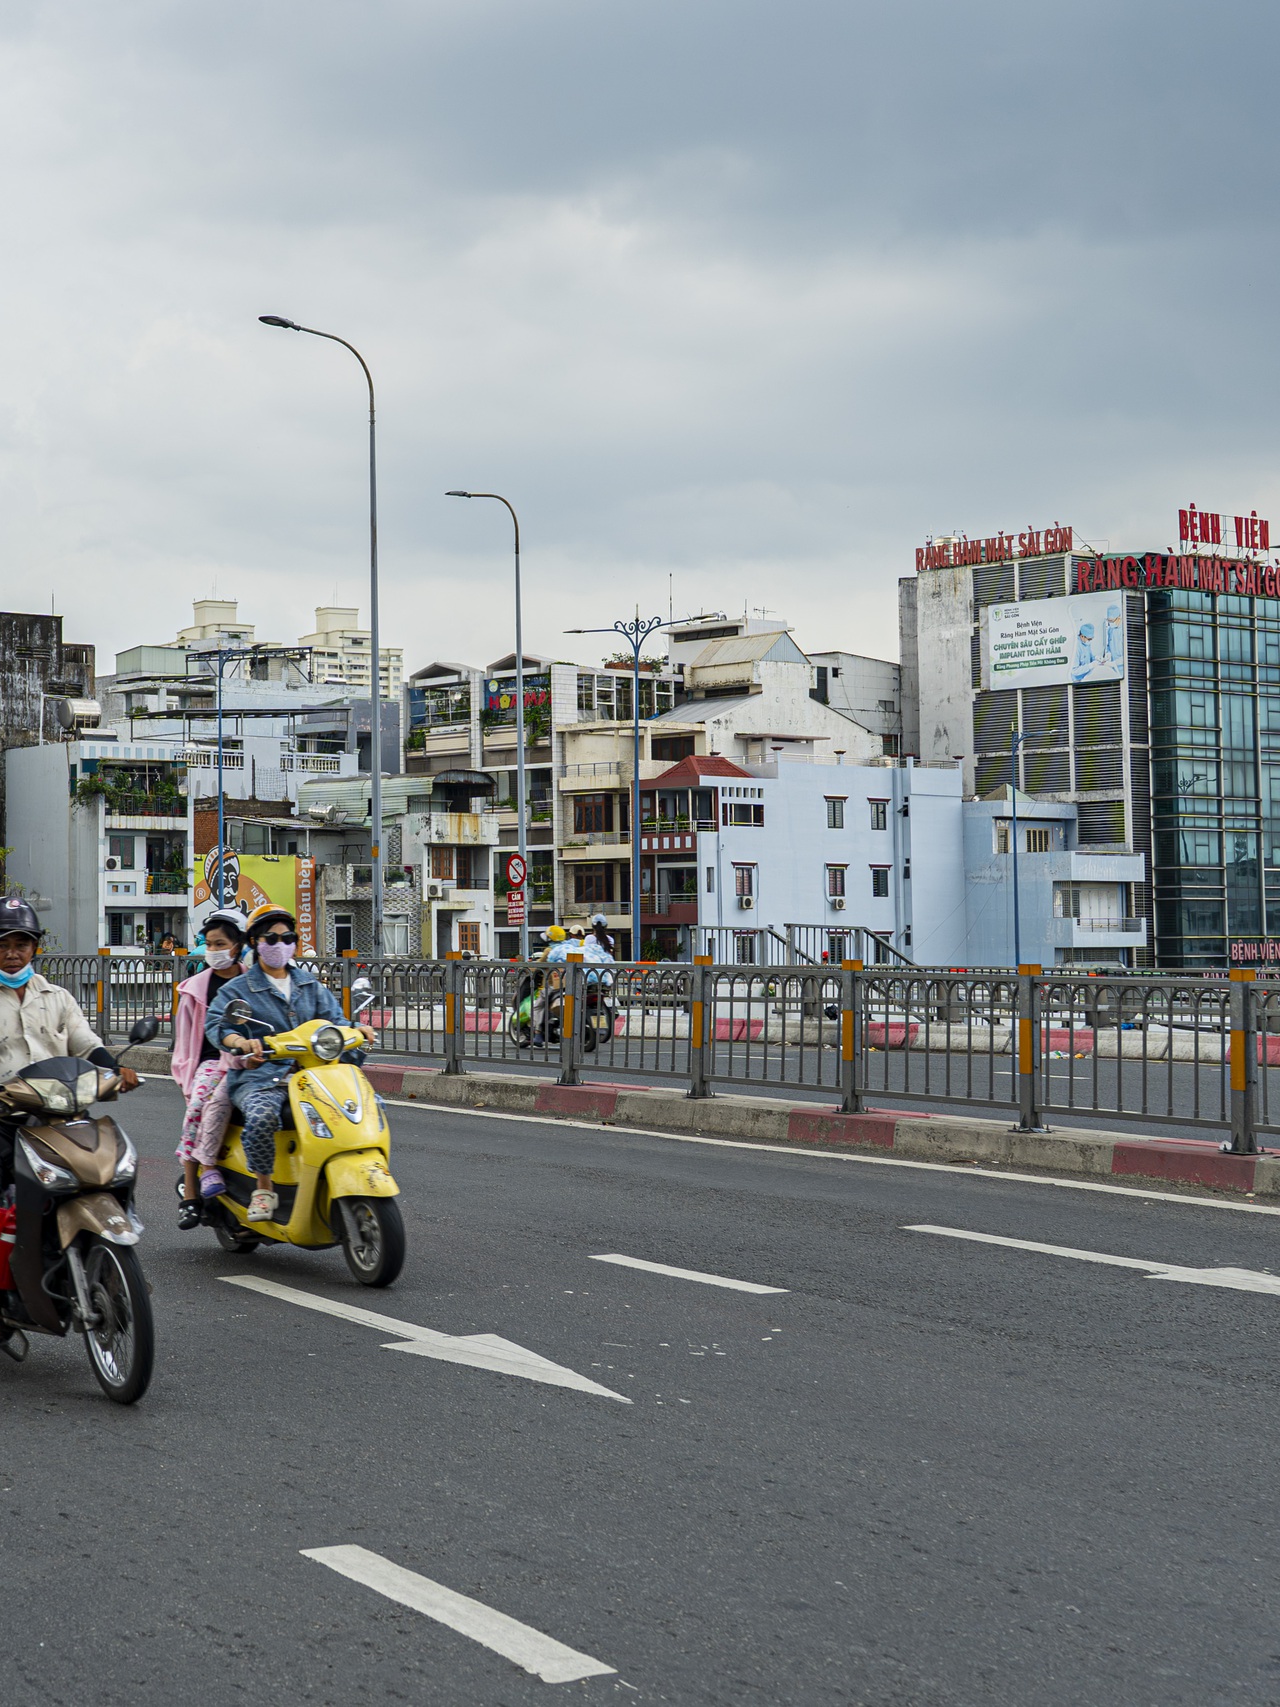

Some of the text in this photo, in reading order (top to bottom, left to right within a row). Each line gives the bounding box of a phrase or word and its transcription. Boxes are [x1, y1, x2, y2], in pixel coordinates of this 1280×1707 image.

[915, 521, 1073, 571] RĂNG HÀM MẶT SÀI GÒN
[1179, 503, 1269, 556] BỆNH VIỆN
[1078, 553, 1137, 592] RĂNG
[1145, 547, 1195, 589] HÀM
[1235, 555, 1261, 595] SÀI
[994, 641, 1018, 651] CHUYÊN
[1000, 651, 1025, 659] IMPLANT
[1232, 939, 1257, 964] BỆNH
